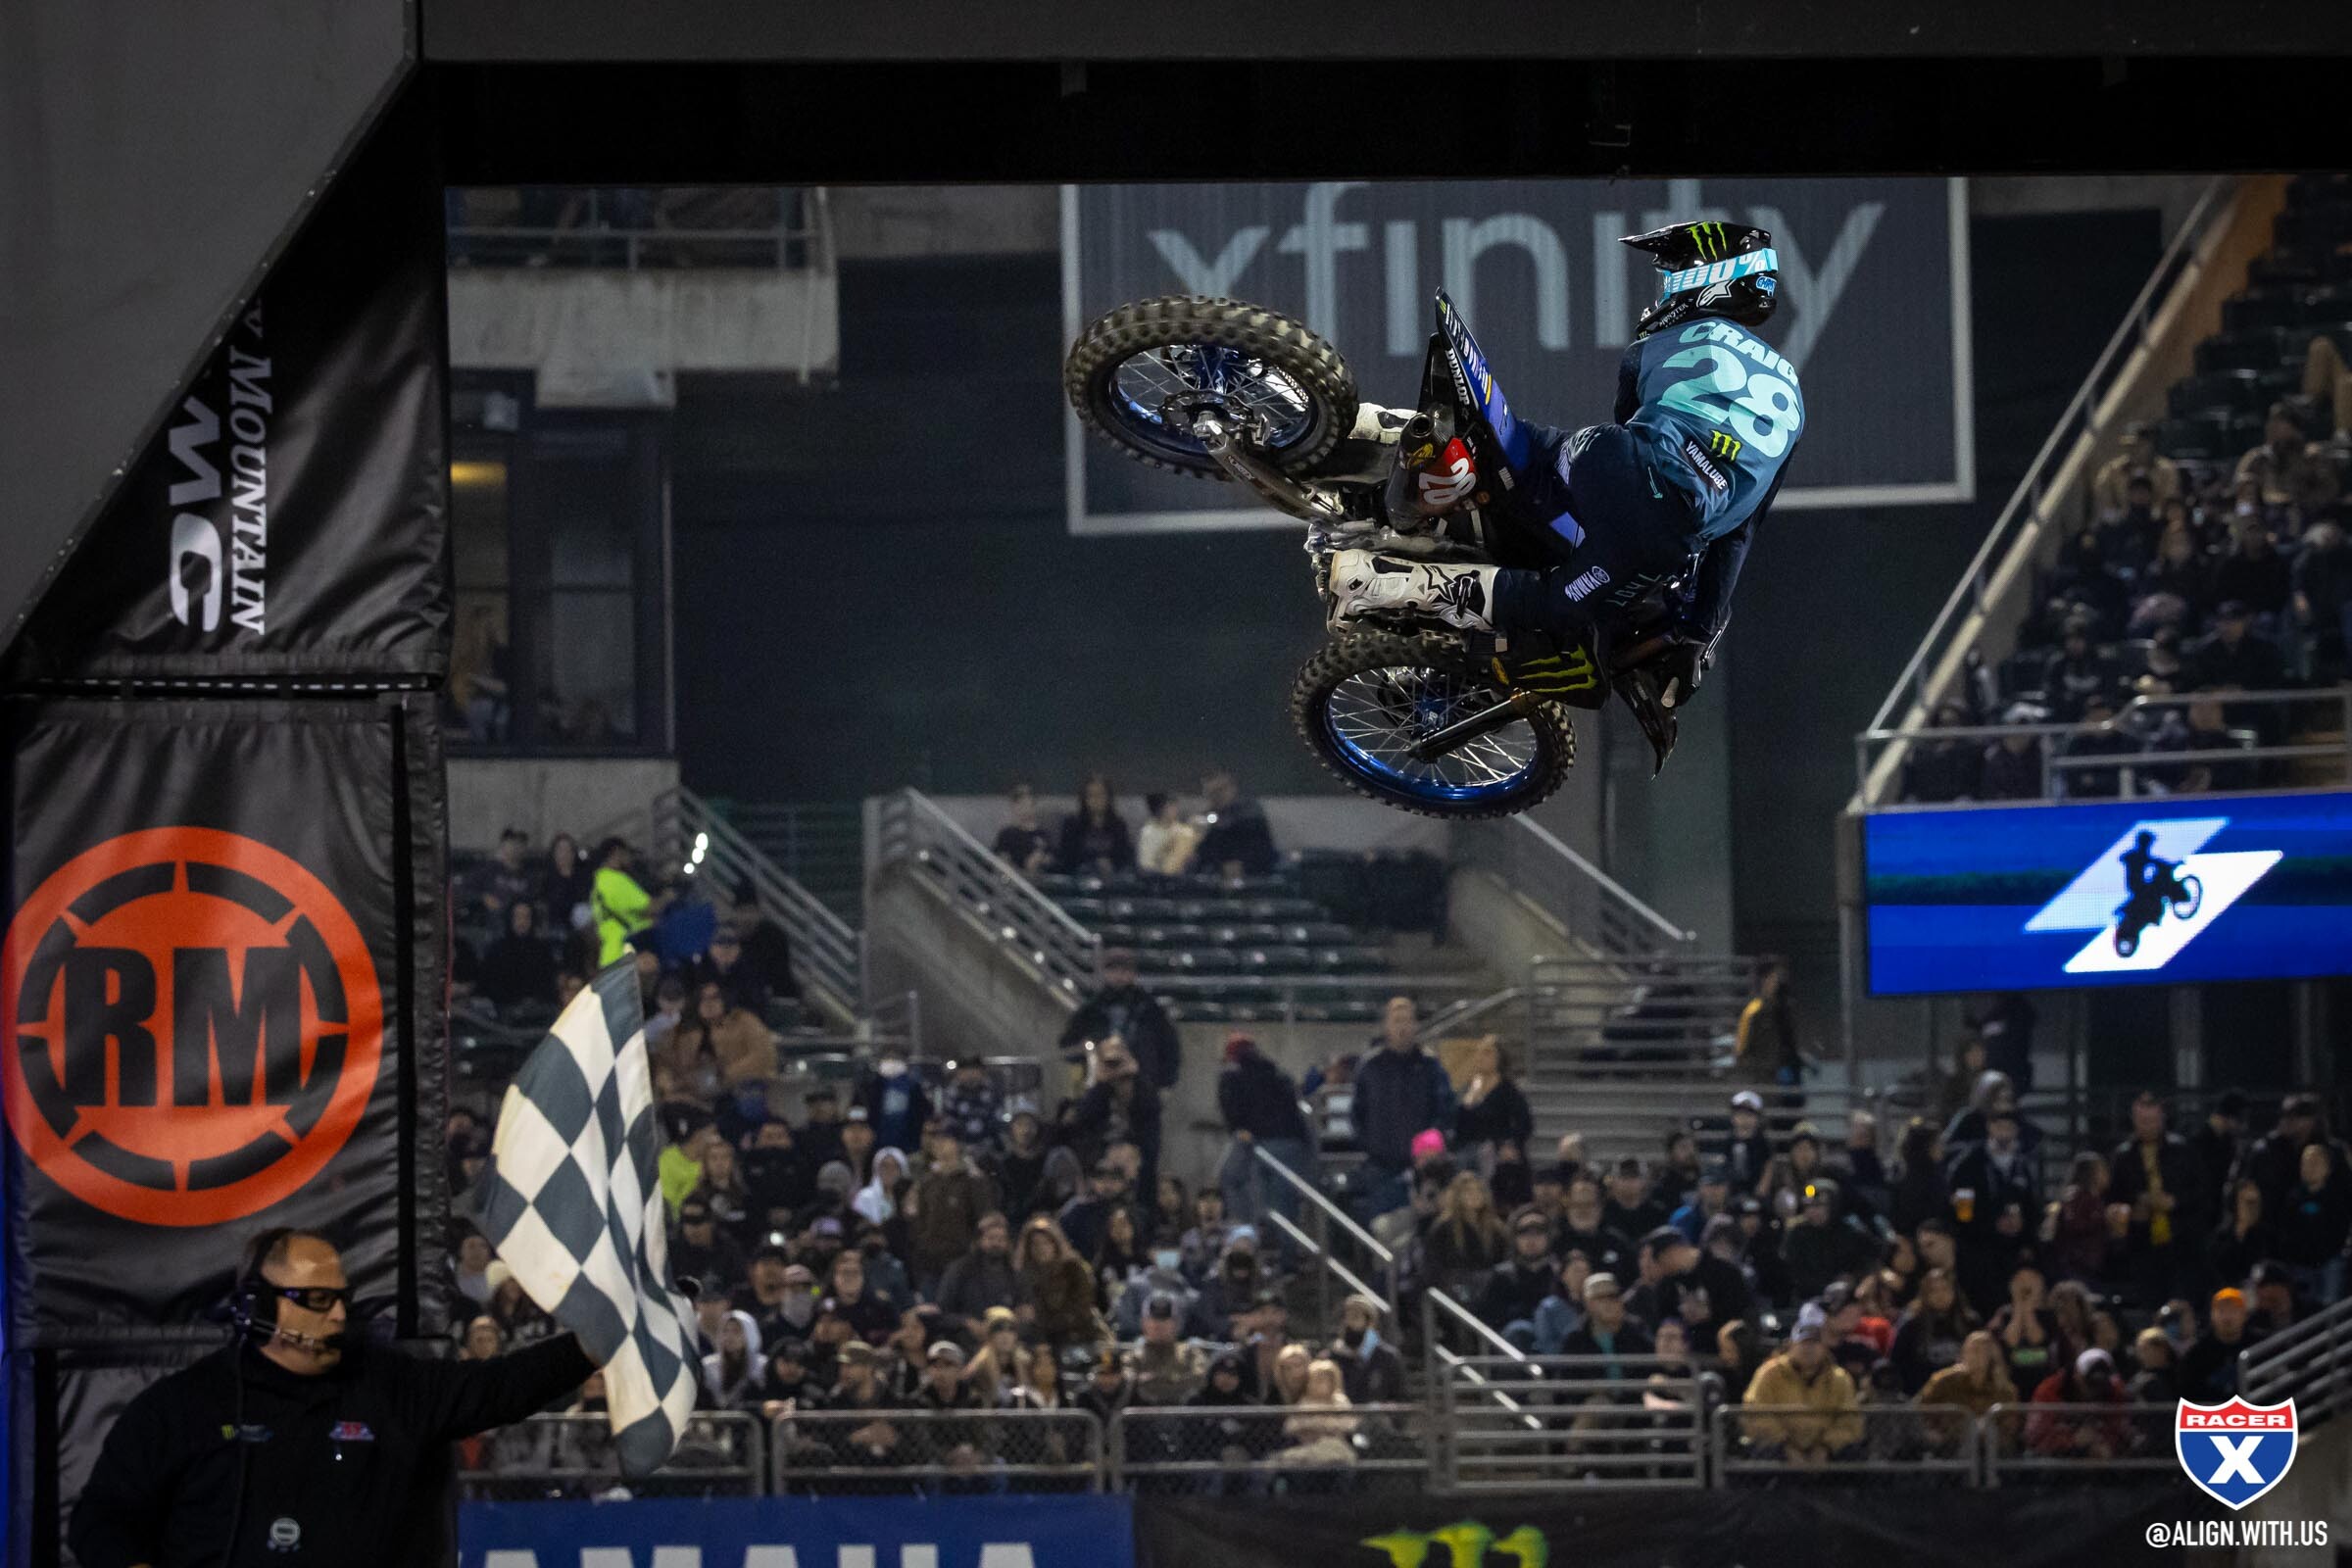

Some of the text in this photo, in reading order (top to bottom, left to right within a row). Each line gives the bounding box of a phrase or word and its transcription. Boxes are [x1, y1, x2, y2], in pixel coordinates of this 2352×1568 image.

[1445, 349, 1470, 407] DUNLOP
[1679, 321, 1799, 386] CRAIG
[1657, 345, 1801, 459] 28
[229, 346, 272, 636] MOUNTAIN
[1418, 457, 1477, 506] 28
[1685, 440, 1729, 490] YAMALUBE
[169, 398, 222, 633] MC
[65, 946, 302, 1107] RM
